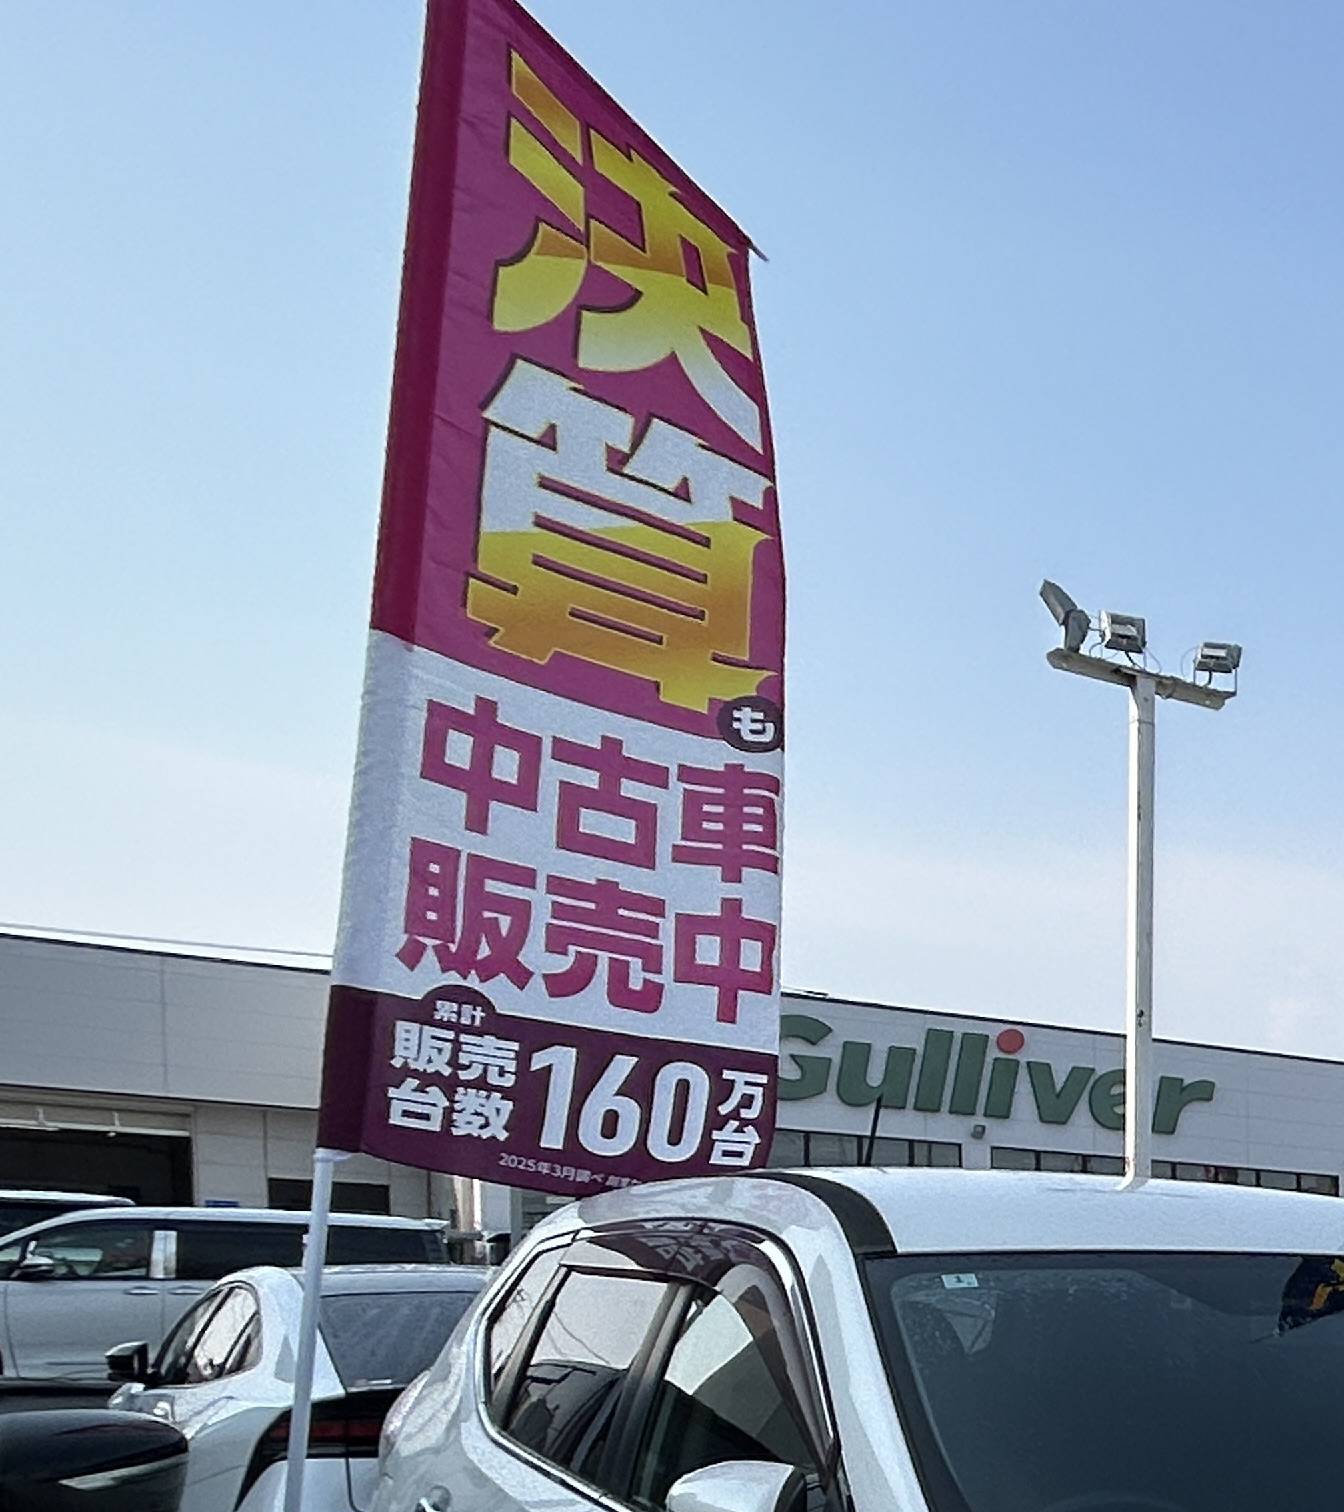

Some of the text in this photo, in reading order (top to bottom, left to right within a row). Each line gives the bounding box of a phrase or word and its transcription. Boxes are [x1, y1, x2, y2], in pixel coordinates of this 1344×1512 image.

[466, 48, 777, 713] 決算
[732, 706, 777, 743] も
[420, 697, 779, 884] 中古車
[396, 837, 777, 1024] 販売中
[390, 1021, 520, 1088] 販売
[432, 1000, 486, 1028] 累計
[387, 1078, 514, 1142] 台数
[531, 1044, 711, 1163] 160
[708, 1069, 768, 1167] 万台
[777, 1013, 1215, 1135] Gulliver
[499, 1152, 605, 1184] 2025年3月調べ
